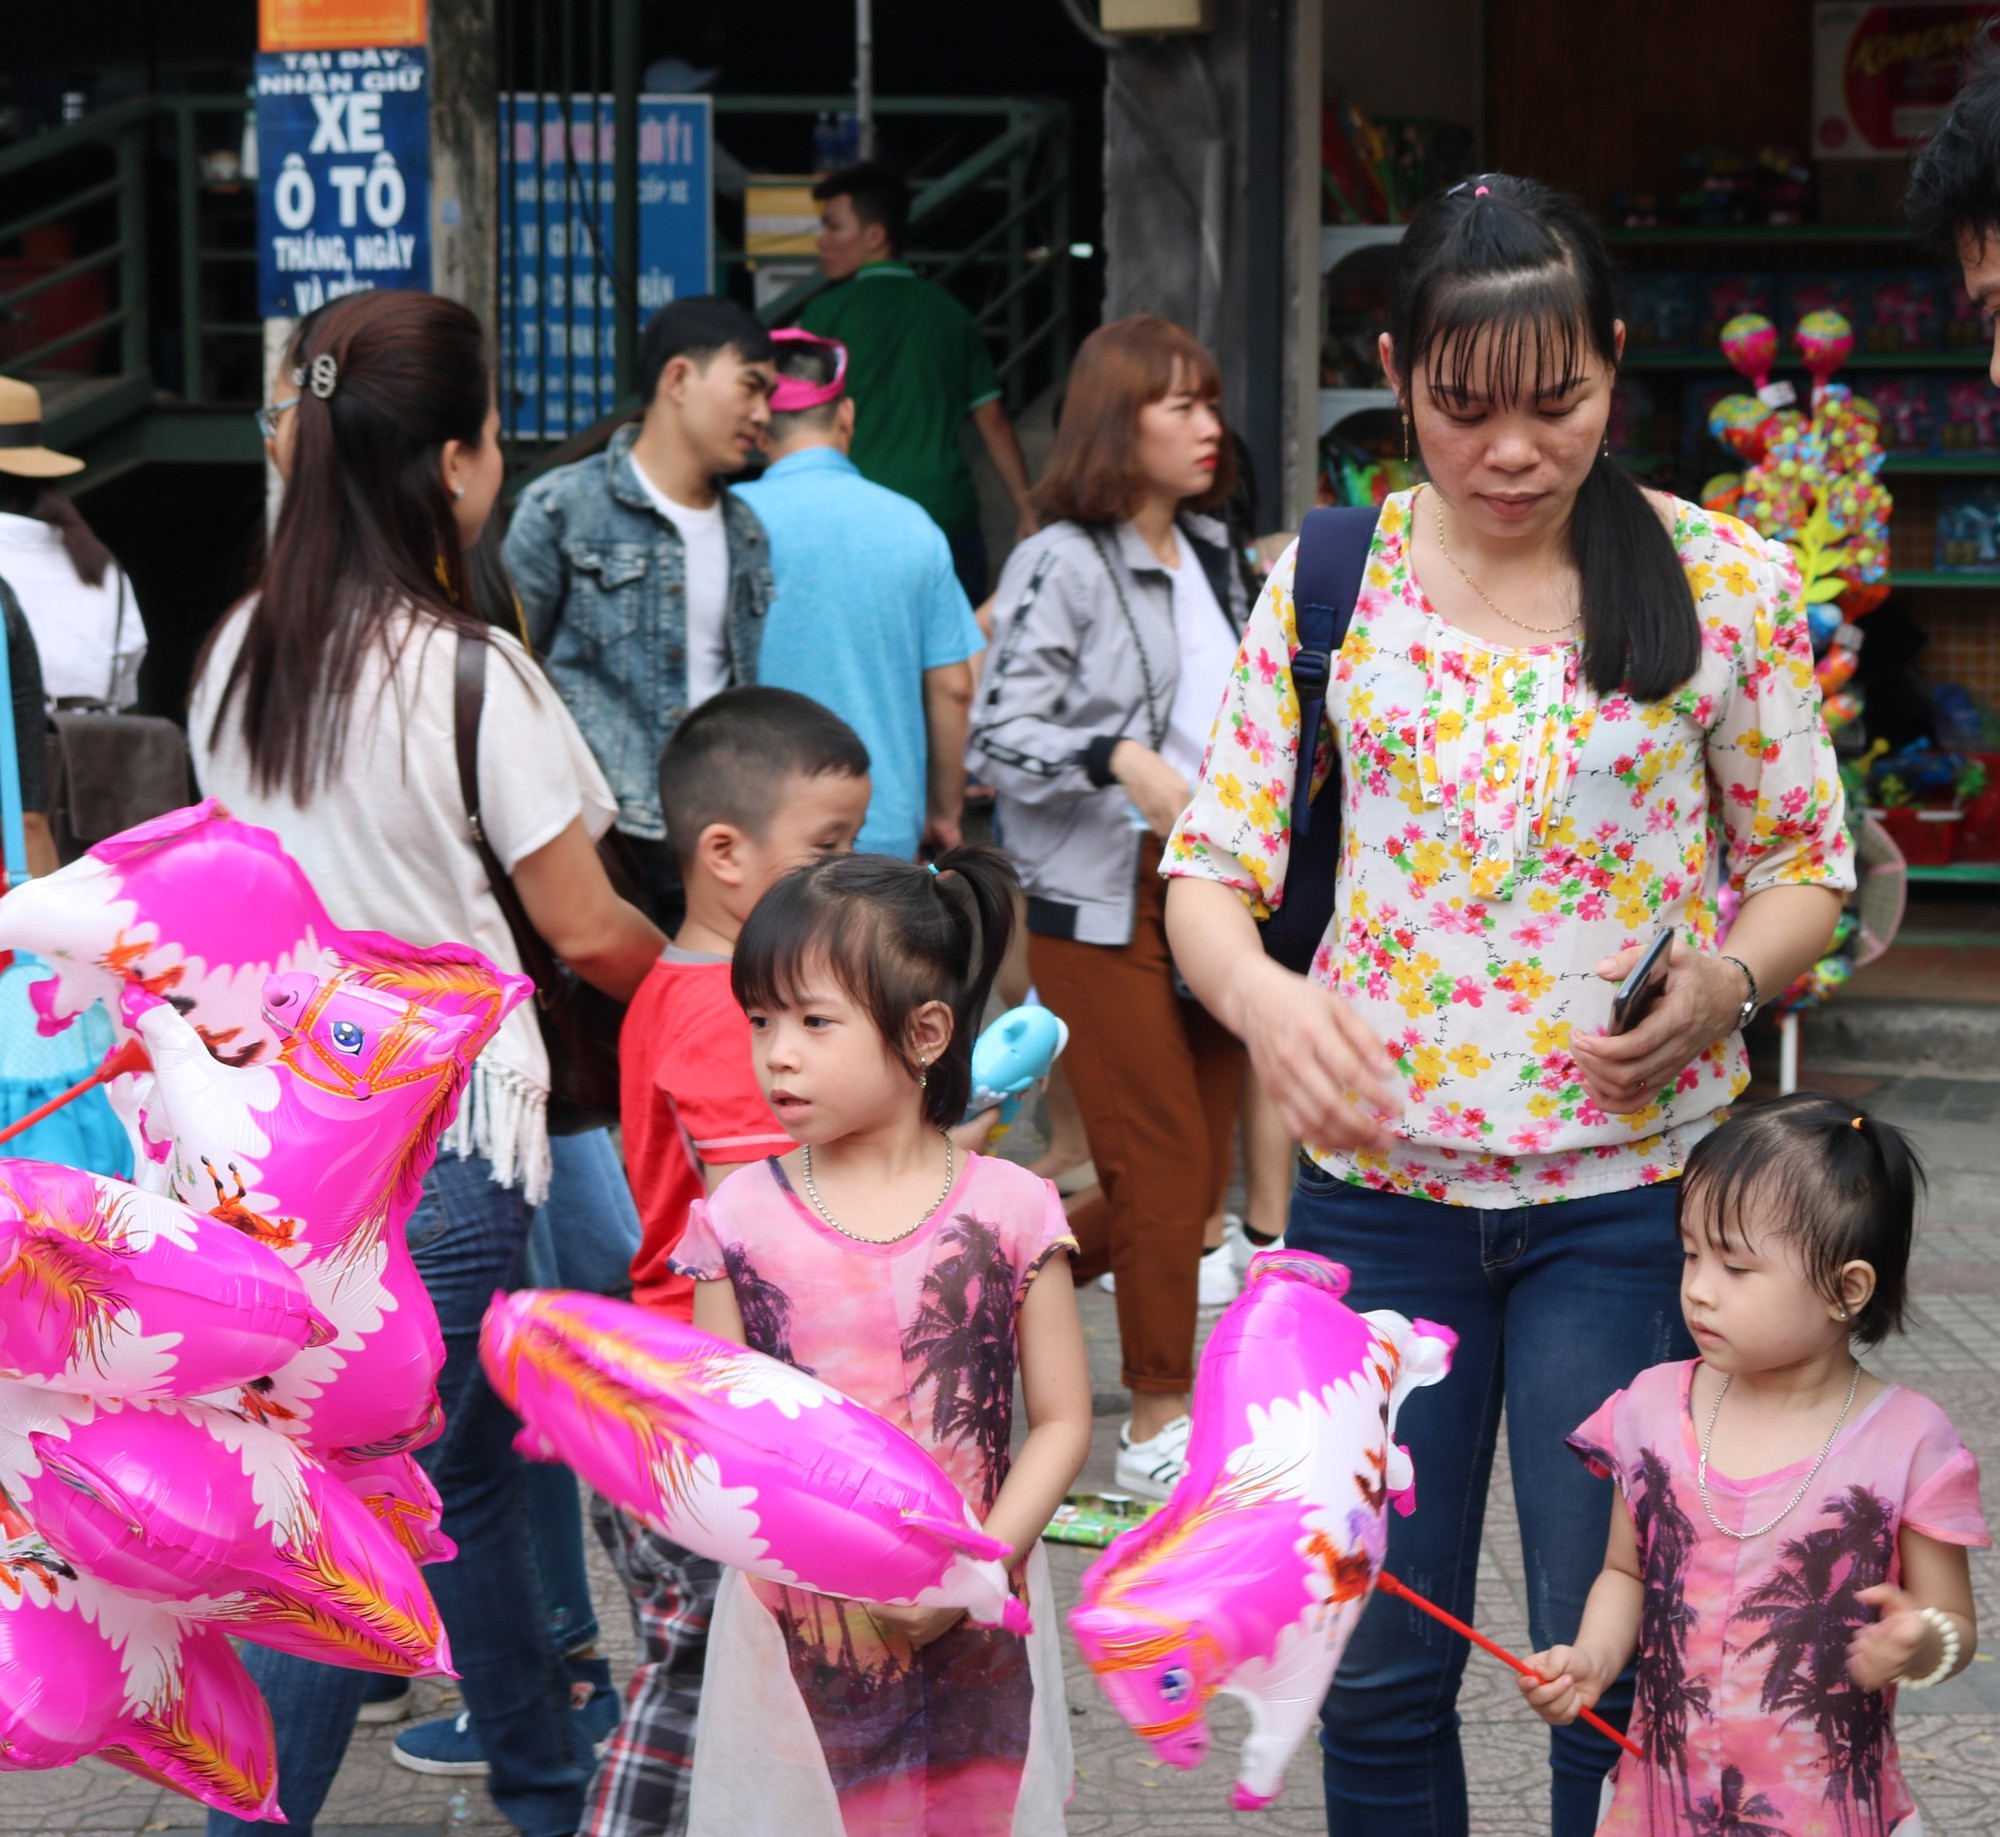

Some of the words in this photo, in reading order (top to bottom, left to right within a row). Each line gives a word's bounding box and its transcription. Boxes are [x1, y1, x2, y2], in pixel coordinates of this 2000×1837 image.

[309, 93, 385, 154] XE
[274, 153, 315, 230] Ô
[329, 152, 406, 229] TÔ
[354, 229, 416, 271] NGÀY
